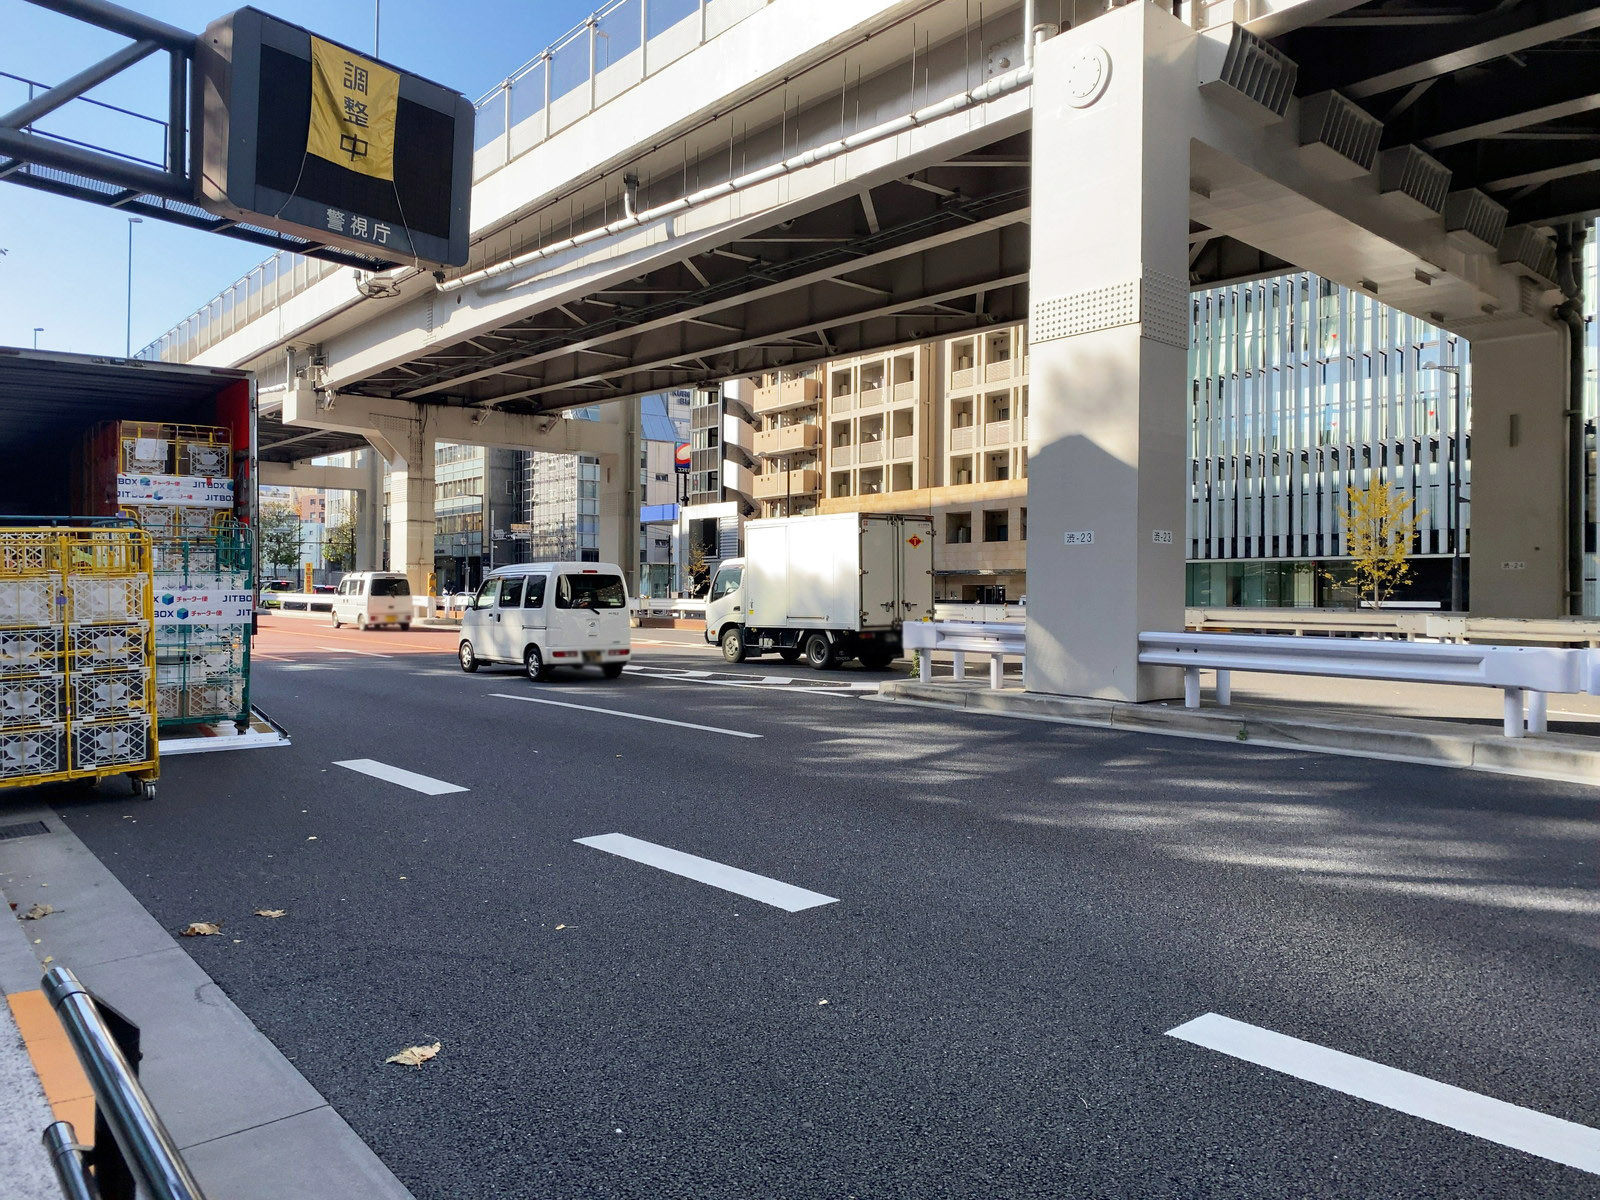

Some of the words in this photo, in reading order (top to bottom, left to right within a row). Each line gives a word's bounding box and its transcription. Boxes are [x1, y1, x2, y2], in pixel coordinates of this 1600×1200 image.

[339, 60, 370, 162] 調整中
[326, 207, 392, 244] 警視庁
[1066, 532, 1092, 544] 渋-23
[222, 594, 252, 602] JITBO
[236, 609, 252, 617] JIT
